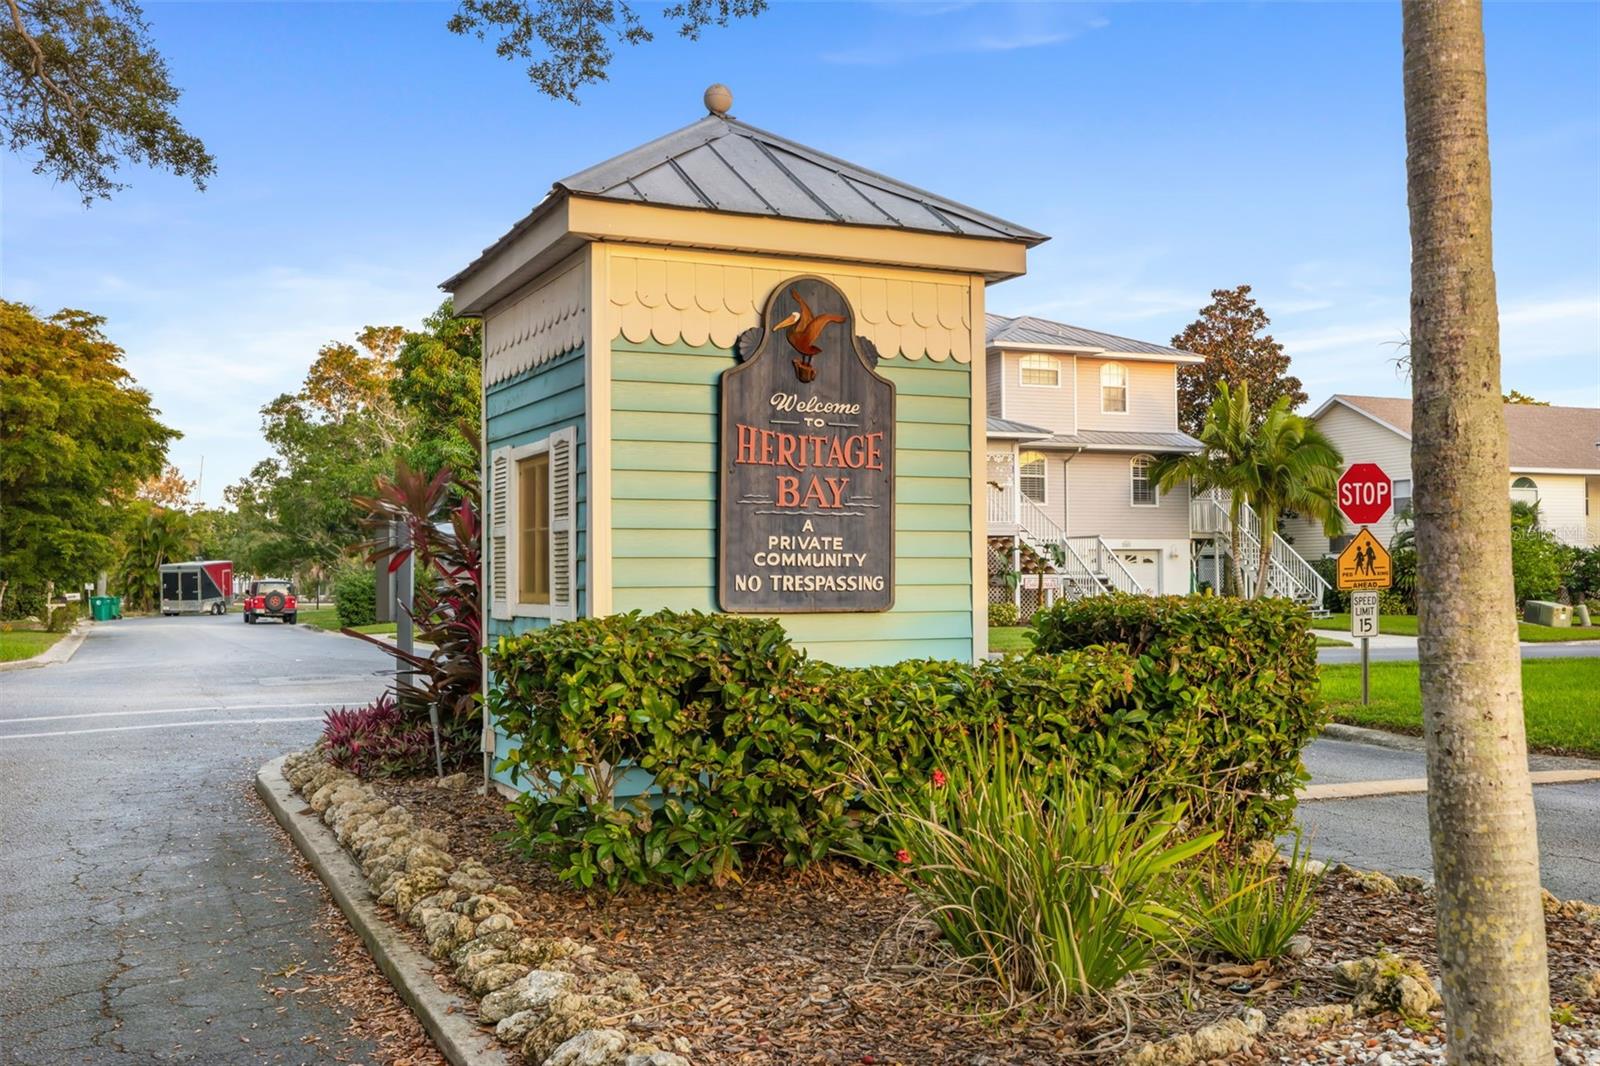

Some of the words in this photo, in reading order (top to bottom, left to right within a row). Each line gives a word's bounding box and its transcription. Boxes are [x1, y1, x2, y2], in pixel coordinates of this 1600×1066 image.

[770, 392, 860, 415] Welcome
[804, 418, 825, 428] TO
[735, 424, 884, 471] HERITAGE
[775, 474, 850, 509] BAY
[1341, 482, 1389, 506] STOP
[802, 519, 814, 532] A
[768, 536, 844, 551] PRIVATE
[754, 552, 867, 567] COMMUNITY
[735, 574, 761, 592] NO
[770, 575, 884, 592] TRESPASSING
[1354, 597, 1377, 606] SPEED
[1355, 607, 1374, 616] LIMIT
[1359, 618, 1372, 633] 15
